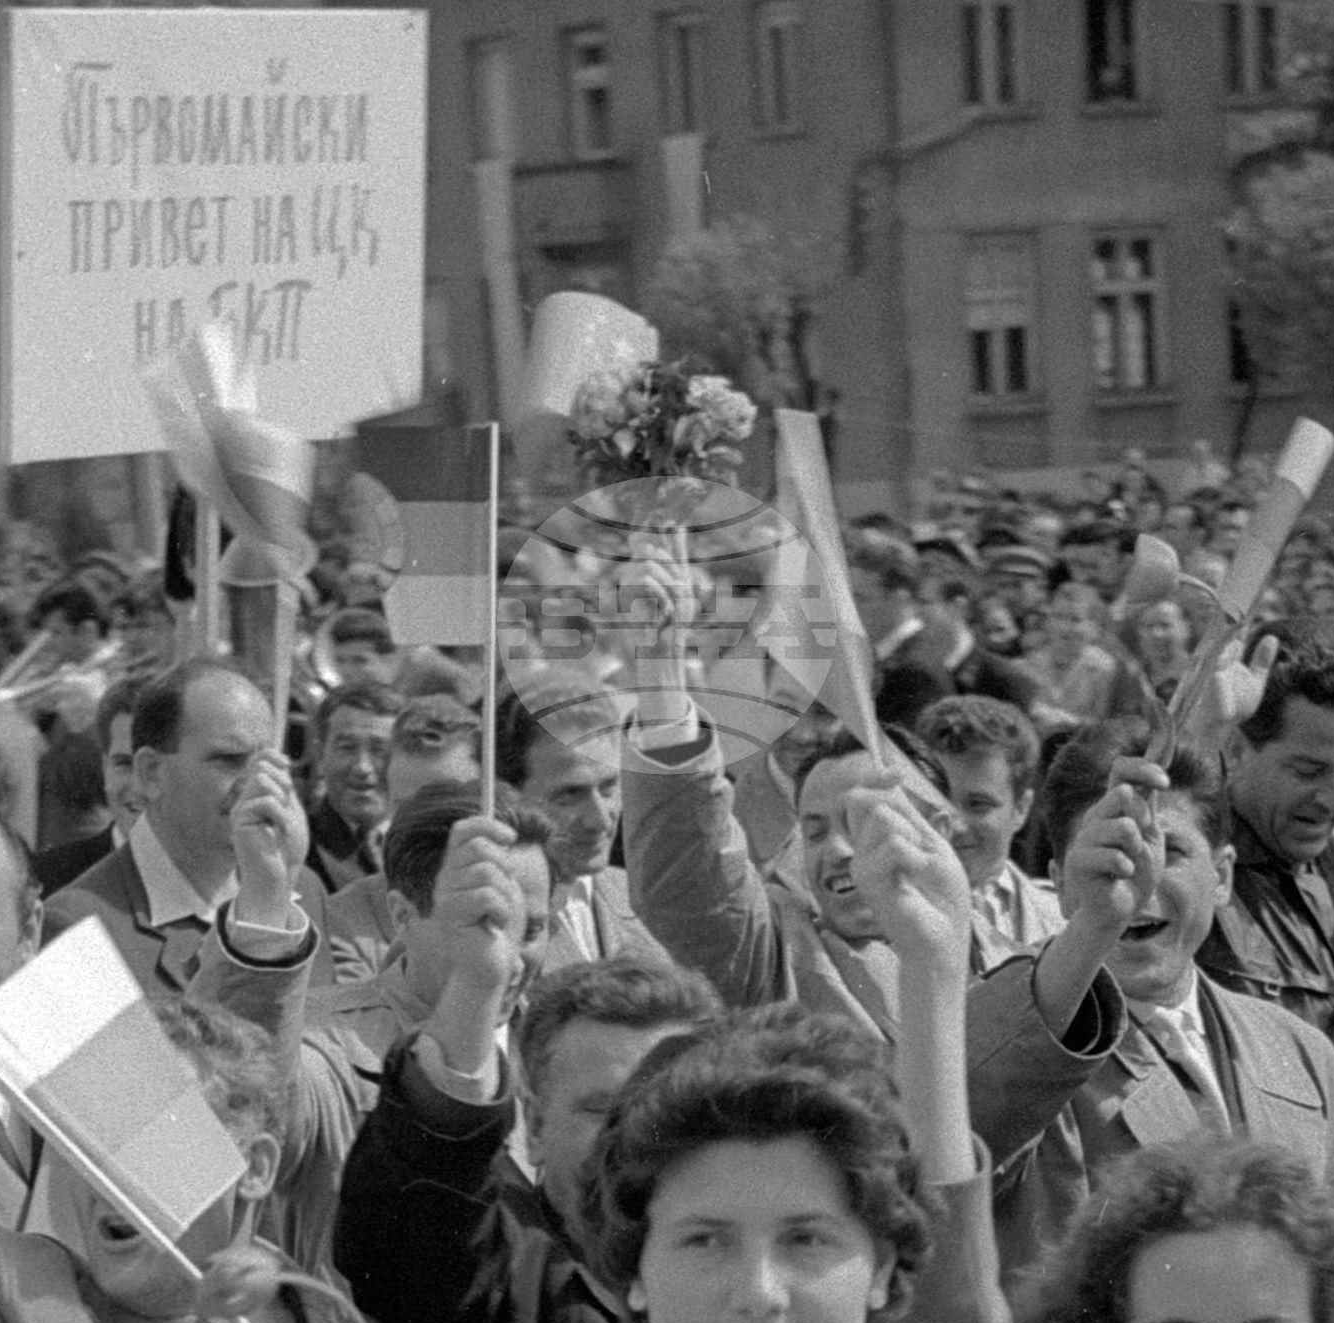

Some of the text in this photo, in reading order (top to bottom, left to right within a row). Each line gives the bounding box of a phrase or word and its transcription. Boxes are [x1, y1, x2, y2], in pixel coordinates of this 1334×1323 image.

[61, 58, 369, 190] ПЪРВОМАЙСКИ
[251, 194, 299, 265] НА
[310, 183, 380, 280] ЦК
[133, 297, 188, 358] НА
